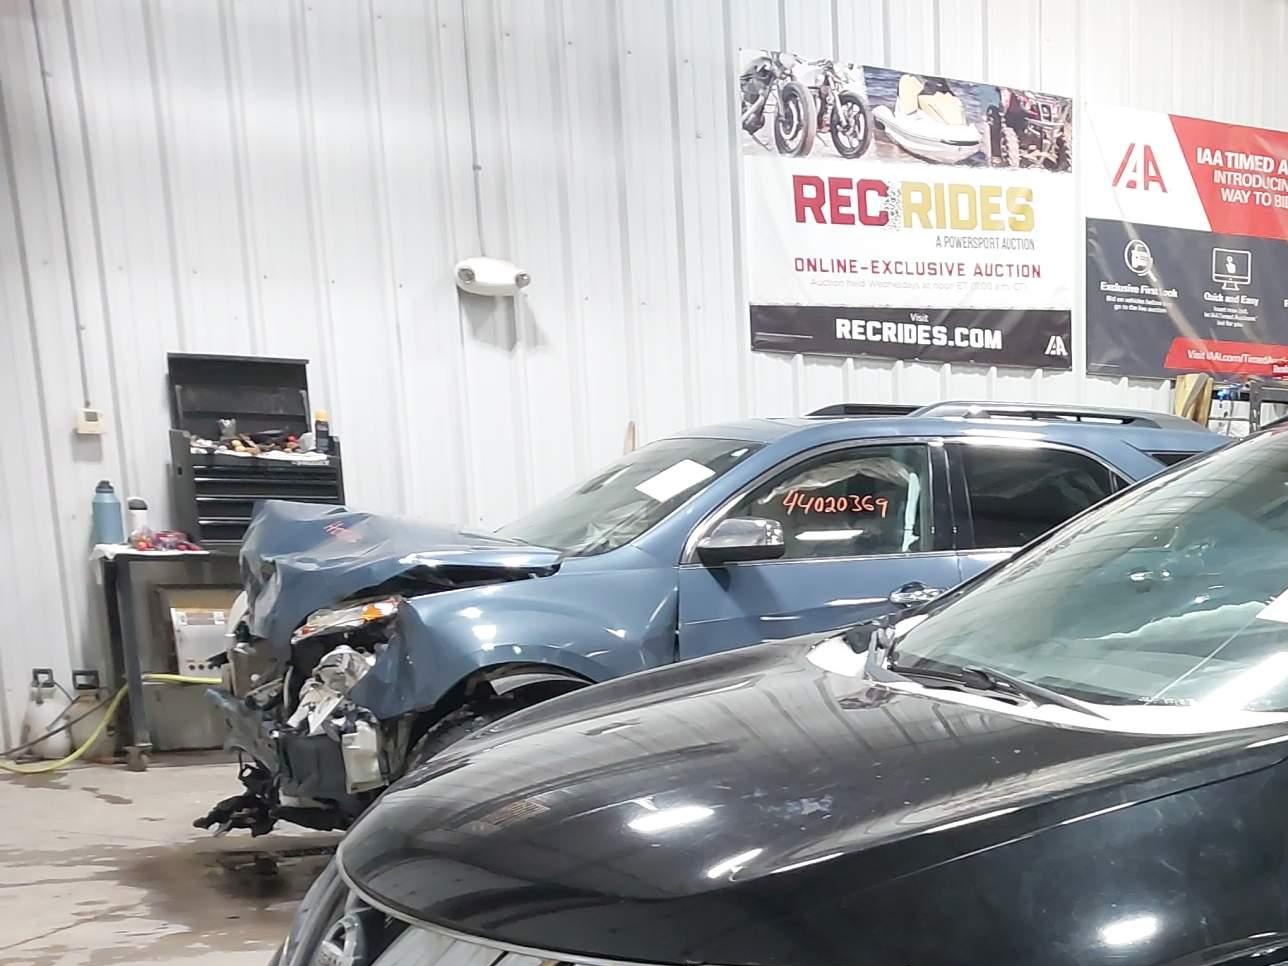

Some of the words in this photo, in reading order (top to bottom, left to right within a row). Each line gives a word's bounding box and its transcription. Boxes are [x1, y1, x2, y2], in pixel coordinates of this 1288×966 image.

[1196, 147, 1223, 167] IAA
[1224, 151, 1274, 173] TIMED
[792, 174, 890, 227] REC
[901, 181, 1036, 232] RIDES
[1220, 188, 1251, 204] WAY
[1253, 191, 1272, 206] TO
[935, 235, 942, 248] A
[944, 235, 1000, 249] POWERSPORT
[1002, 238, 1035, 250] AUCTION
[794, 257, 966, 277] ONLINE-EXCLUSIVE
[973, 263, 1042, 278] AUCTION
[1204, 291, 1224, 302] Quick
[1225, 295, 1240, 304] and
[1240, 295, 1260, 306] Easy
[909, 313, 929, 323] Visit
[835, 318, 1003, 350] RECRIDES.COM
[1187, 349, 1205, 360] Visit
[783, 489, 889, 518] 44020369
